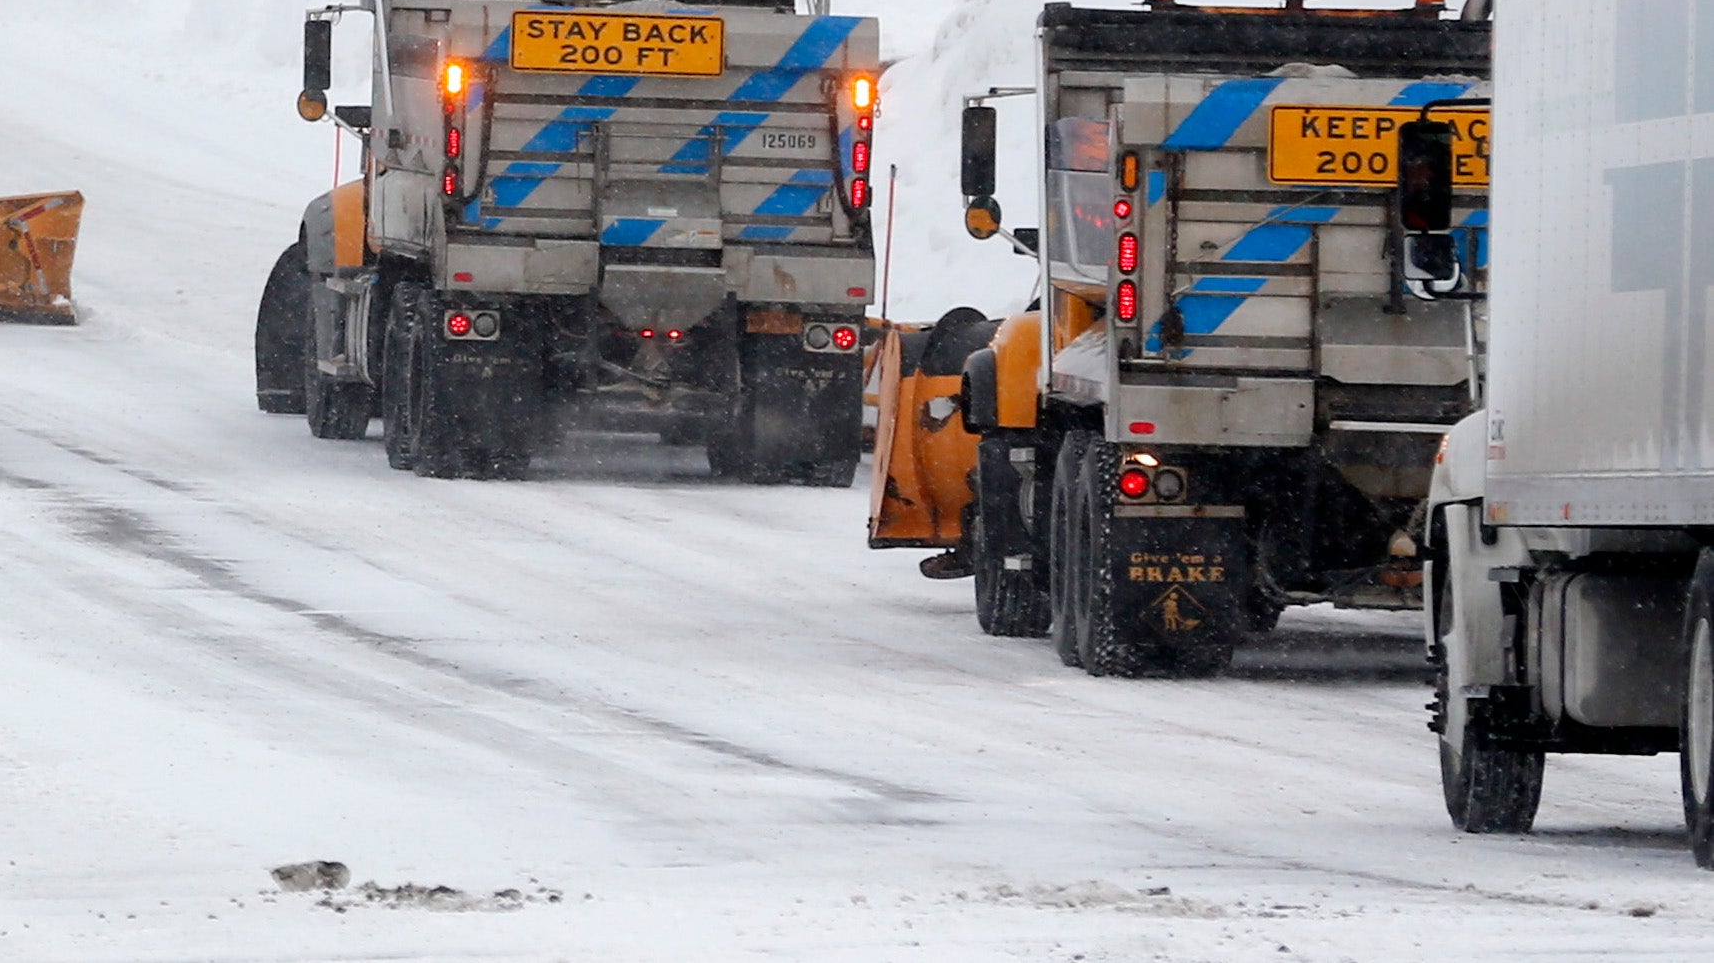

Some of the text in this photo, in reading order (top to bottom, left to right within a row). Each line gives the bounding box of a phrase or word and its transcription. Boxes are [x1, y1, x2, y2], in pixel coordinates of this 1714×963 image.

[527, 20, 709, 44] STAY BACK
[560, 44, 675, 67] 200 FT
[1301, 115, 1396, 139] KEEP
[762, 133, 817, 149] 125069
[1317, 150, 1389, 174] 200
[1130, 552, 1169, 564] Give
[1128, 566, 1226, 583] BRAKE
